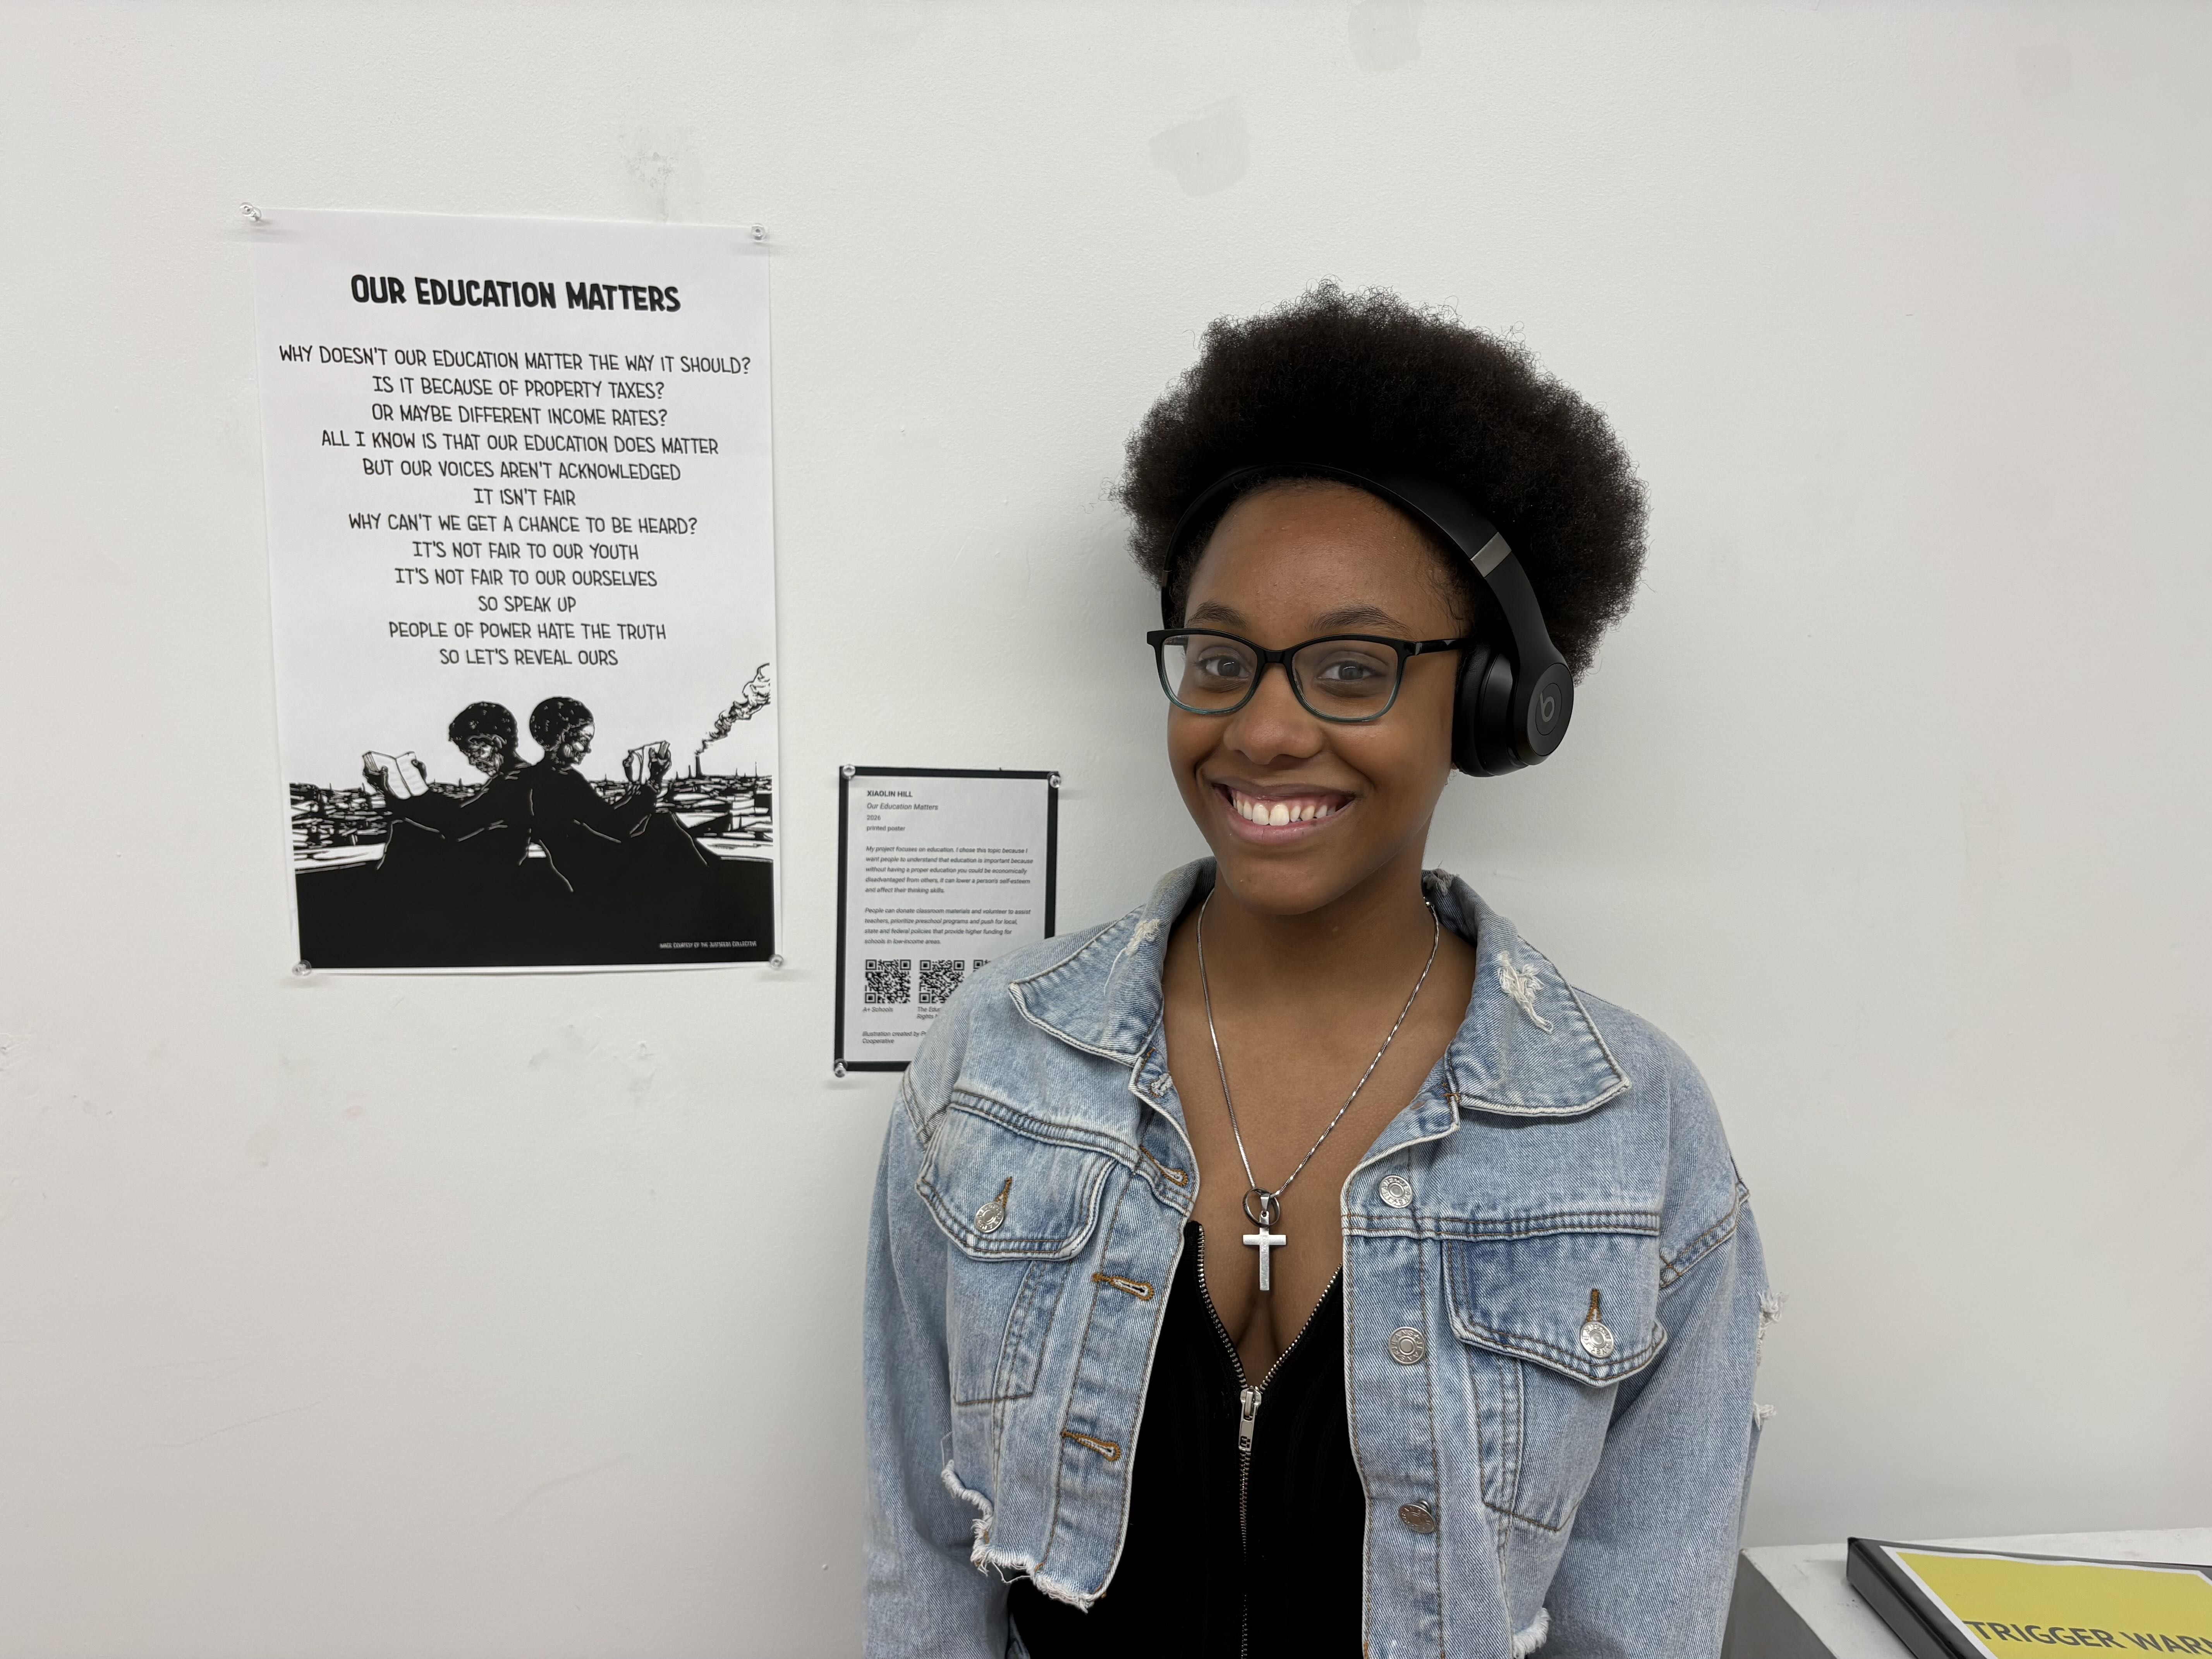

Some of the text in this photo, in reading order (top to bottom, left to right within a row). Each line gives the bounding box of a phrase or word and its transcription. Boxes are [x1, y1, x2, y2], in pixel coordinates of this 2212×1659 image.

[351, 274, 681, 312] OUR EDUCATION MATTERS
[279, 344, 750, 374] WHY DOESN'T OUR EDUCATION MATTER THE WAY IT SHOULD?
[372, 376, 665, 399] IS IT BECAUSE OF PROPERTY TAXES?
[372, 403, 667, 426] OR MAYBE DIFFERENT INCOME RATES?
[322, 429, 718, 455] ALL I KNOW IS THAT OUR EDUCATION DOES MATTER
[362, 458, 681, 481] BUT OUR VOICES AREN'T ACKNOWLEDGED
[473, 488, 576, 506] IT ISN'T FAIR
[349, 512, 697, 534] WHY CAN'T WE GET A CHANCE TO BE HEARD?
[412, 541, 639, 560] IT'S NOT FAIR TO OUR YOUTH
[394, 567, 658, 587] IT'S NOT FAIR TO OUR OURSELVES
[478, 595, 576, 613] SO SPEAK UP
[389, 621, 666, 640] PEOPLE OF POWER HATE THE TRUTH
[440, 648, 618, 666] SO LET'S REVEAL OURS
[1962, 1620, 2128, 1649] TRIGGER
